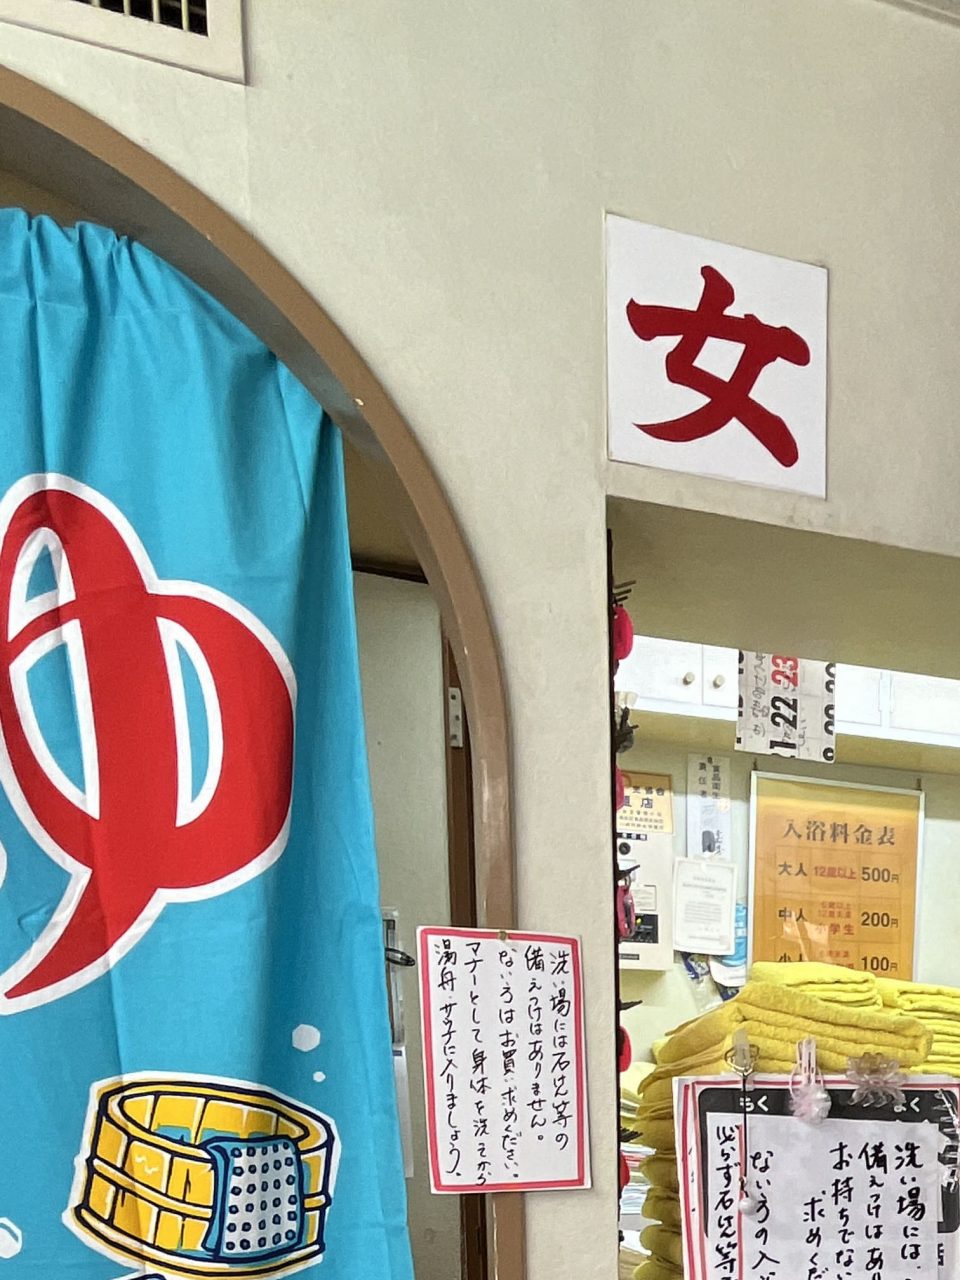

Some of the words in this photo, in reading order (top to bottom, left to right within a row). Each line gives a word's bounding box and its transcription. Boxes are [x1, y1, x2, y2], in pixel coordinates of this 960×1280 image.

[626, 265, 811, 469] 女
[0, 472, 298, 1015] ゆ
[770, 696, 798, 730] 22
[778, 861, 808, 877] 大人
[861, 866, 900, 884] 500円
[783, 820, 896, 846] 入浴料金表
[778, 907, 808, 922] 中人
[861, 911, 899, 929] 200円
[861, 956, 898, 972] 100円
[464, 942, 493, 1186] マナーとして身体を洗ってから
[525, 945, 548, 1142] 備えつけはありません。
[549, 951, 573, 1151] 洗い場には石けん等の
